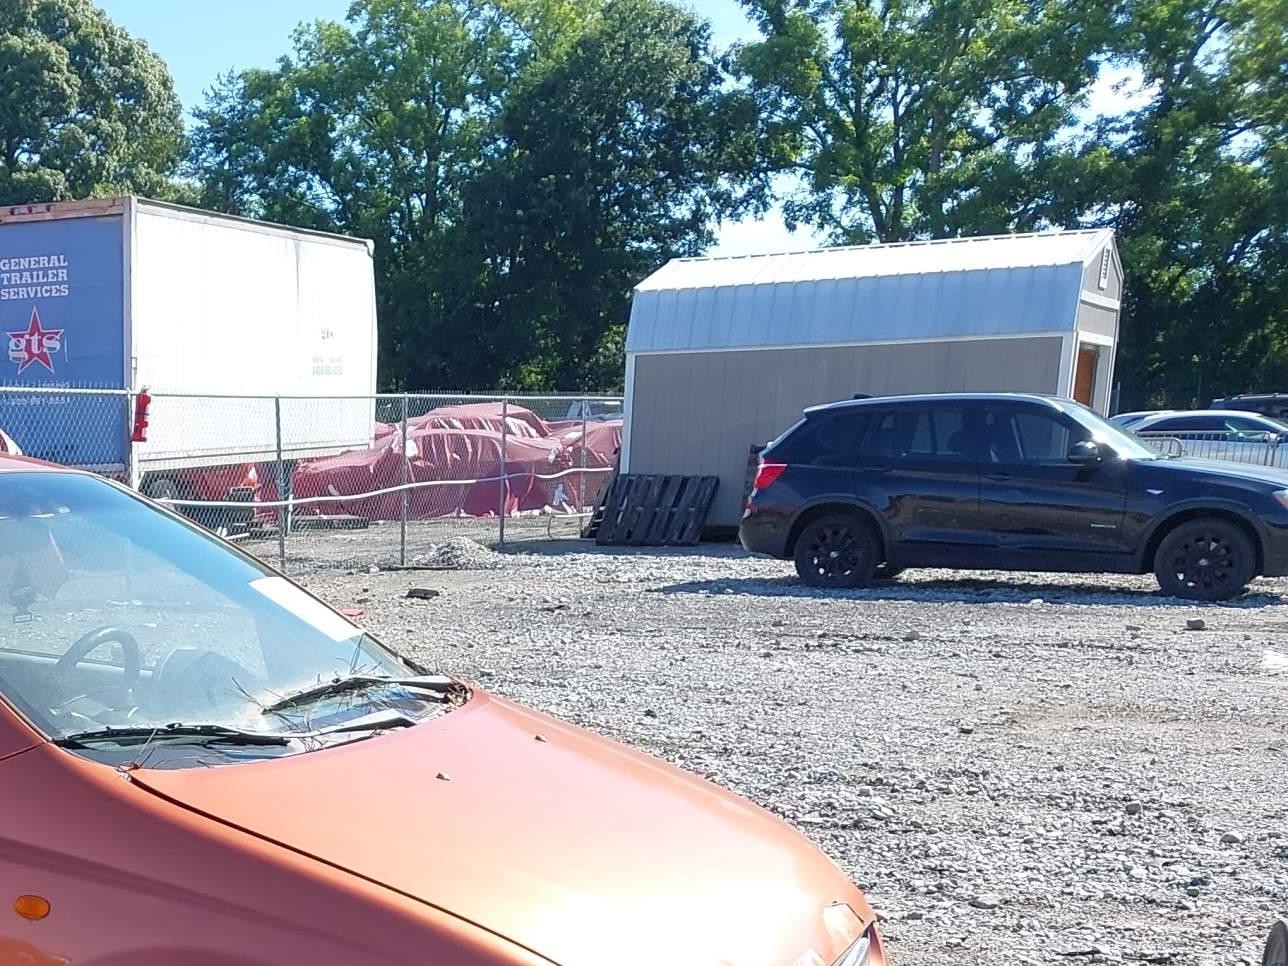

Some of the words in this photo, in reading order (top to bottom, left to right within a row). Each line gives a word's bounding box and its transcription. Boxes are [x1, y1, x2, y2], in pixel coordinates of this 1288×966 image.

[0, 255, 68, 271] GENERAL
[0, 269, 68, 285] TRAILER
[0, 285, 69, 300] SERVICES
[8, 330, 61, 363] gts
